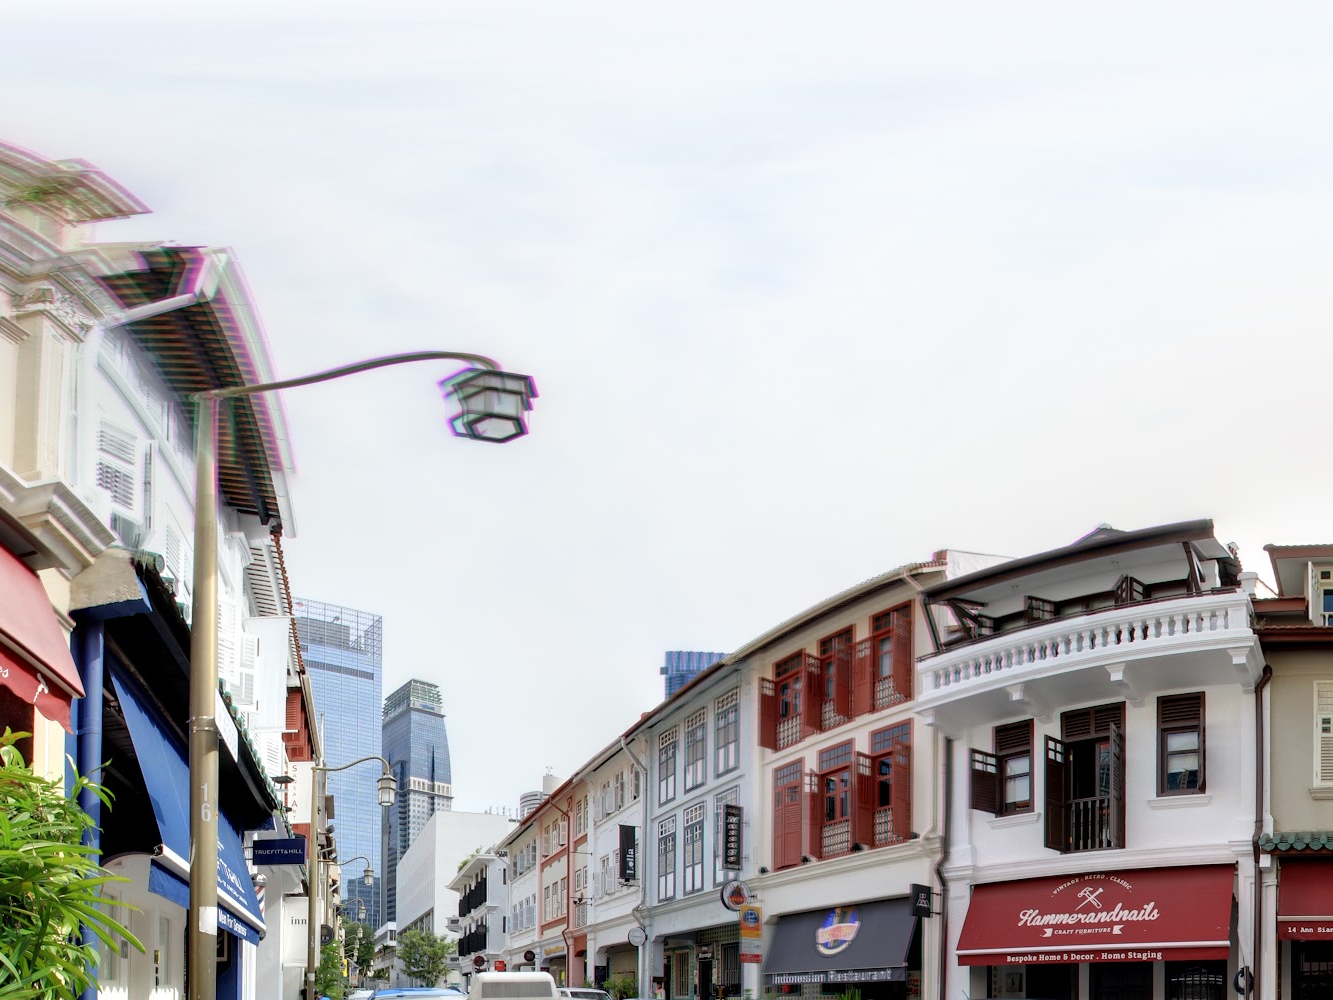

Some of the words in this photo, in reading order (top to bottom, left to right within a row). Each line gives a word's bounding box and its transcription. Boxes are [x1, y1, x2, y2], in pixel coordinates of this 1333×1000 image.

[1053, 878, 1079, 894] VINTAGE
[1110, 876, 1132, 890] CLASSIC
[290, 917, 307, 925] inn
[1018, 901, 1160, 927] Hammerandnails
[1007, 954, 1037, 963] Bespoke
[1071, 953, 1095, 961] Decor
[1101, 952, 1125, 960] Home
[1127, 951, 1162, 960] Staging
[772, 972, 826, 984] Indonesian
[828, 968, 892, 982] Restaurant
